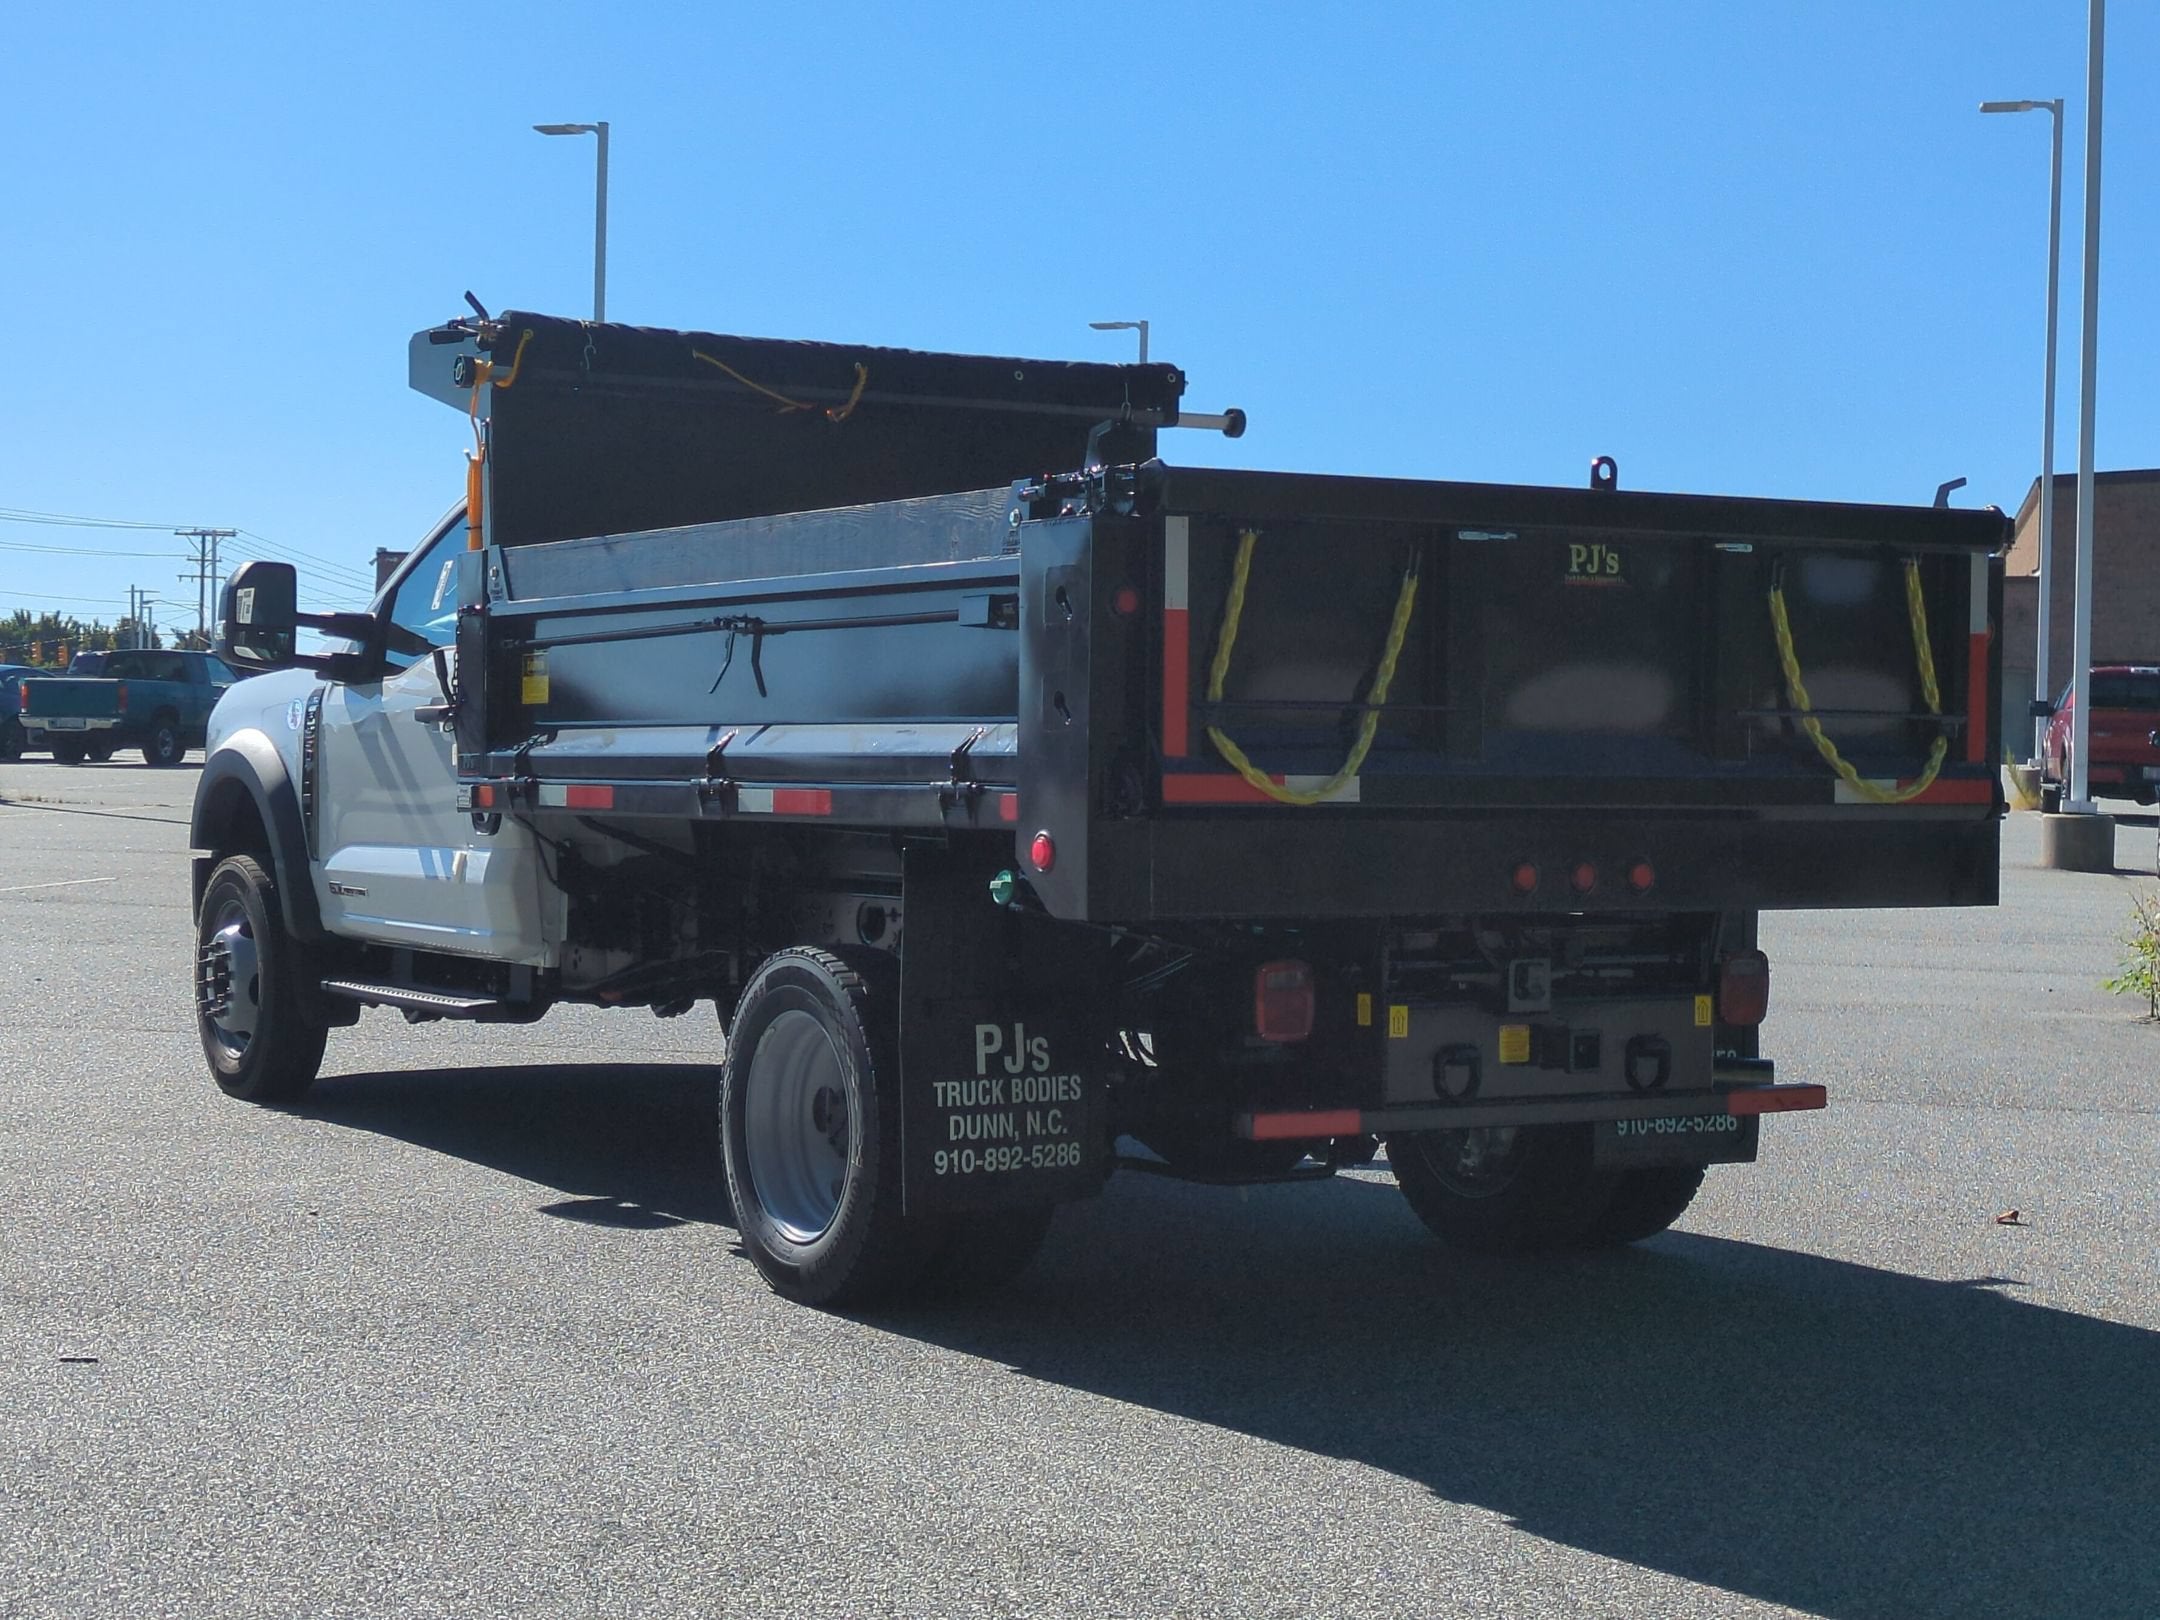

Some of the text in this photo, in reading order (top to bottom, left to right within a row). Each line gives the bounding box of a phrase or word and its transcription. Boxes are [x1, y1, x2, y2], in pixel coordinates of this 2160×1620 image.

[1568, 543, 1620, 575] PJ's
[975, 1022, 1051, 1076] PJ's
[933, 1075, 1082, 1108] TRUCK BODIES
[949, 1109, 1068, 1142] DUNN, N.C.
[934, 1142, 1081, 1176] 910-892-5286
